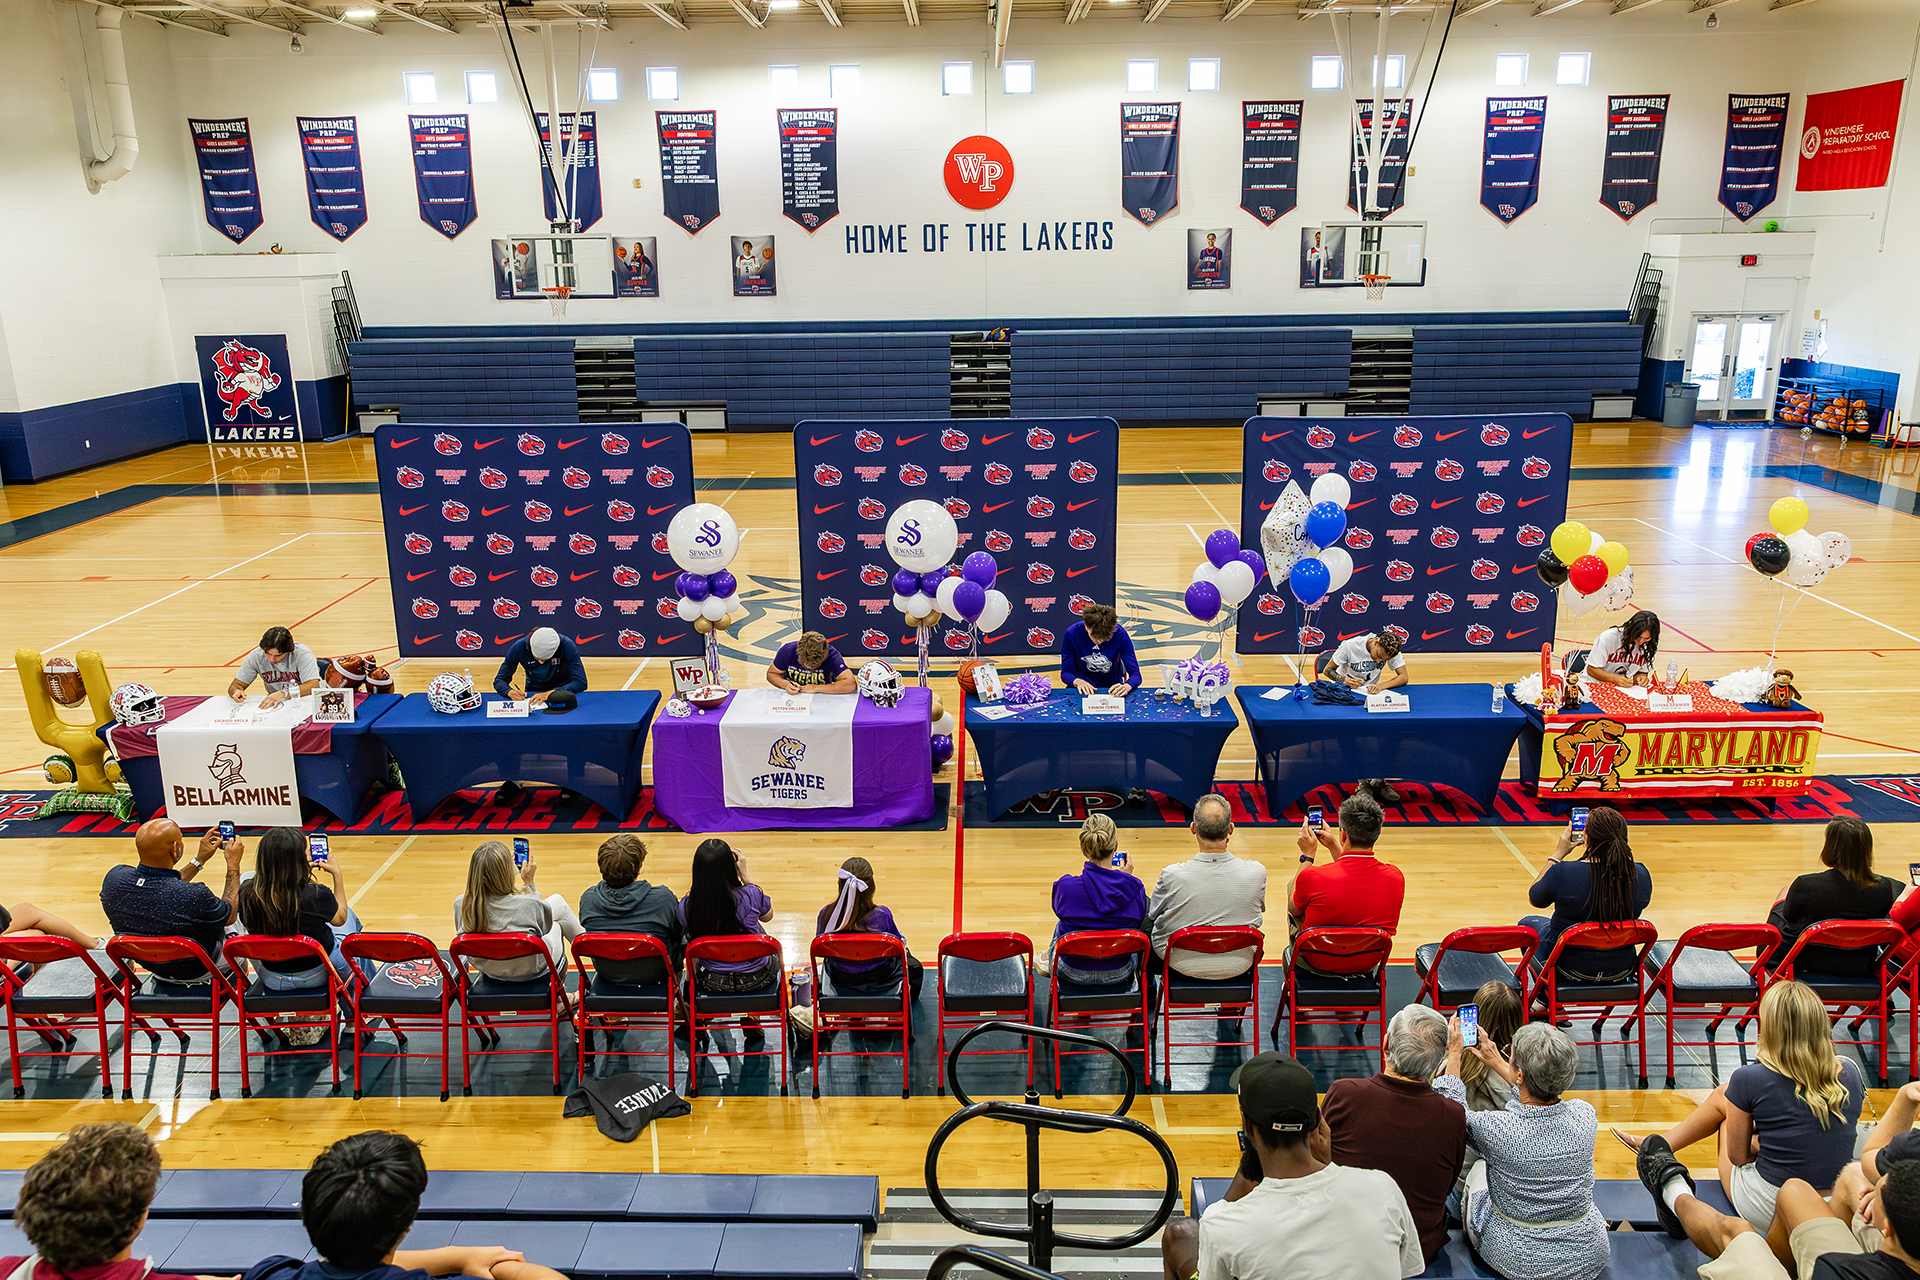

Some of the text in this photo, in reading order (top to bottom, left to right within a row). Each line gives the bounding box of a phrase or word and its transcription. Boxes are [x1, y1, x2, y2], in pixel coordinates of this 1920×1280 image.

[1489, 99, 1544, 112] WINDERMERE
[1611, 98, 1666, 110] WINDERMERE
[1731, 97, 1787, 109] WINDERMERE
[1123, 105, 1178, 118] WINDERMERE
[1246, 104, 1300, 116] WINDERMERE
[411, 117, 466, 130] WINDERMERE
[660, 113, 713, 126] WINDERMERE
[780, 111, 834, 124] WINDERMERE
[192, 121, 246, 134] WINDERMERE
[300, 119, 354, 132] WINDERMERE
[954, 153, 1004, 192] WP
[845, 221, 1114, 254] HOME OF THE LAKERS
[214, 426, 295, 440] LAKERS
[688, 548, 724, 557] SEWANEE
[893, 546, 925, 555] SEWANEE
[676, 666, 704, 685] WP
[787, 669, 825, 686] TIGERS
[1666, 695, 1675, 703] M
[328, 704, 339, 713] 99
[1635, 730, 1810, 767] MARYLAND
[1571, 742, 1621, 776] M
[751, 772, 825, 791] SEWANEE
[1742, 778, 1800, 788] EST. 1856
[173, 785, 292, 807] BELLARMINE
[769, 788, 808, 800] TIGERS
